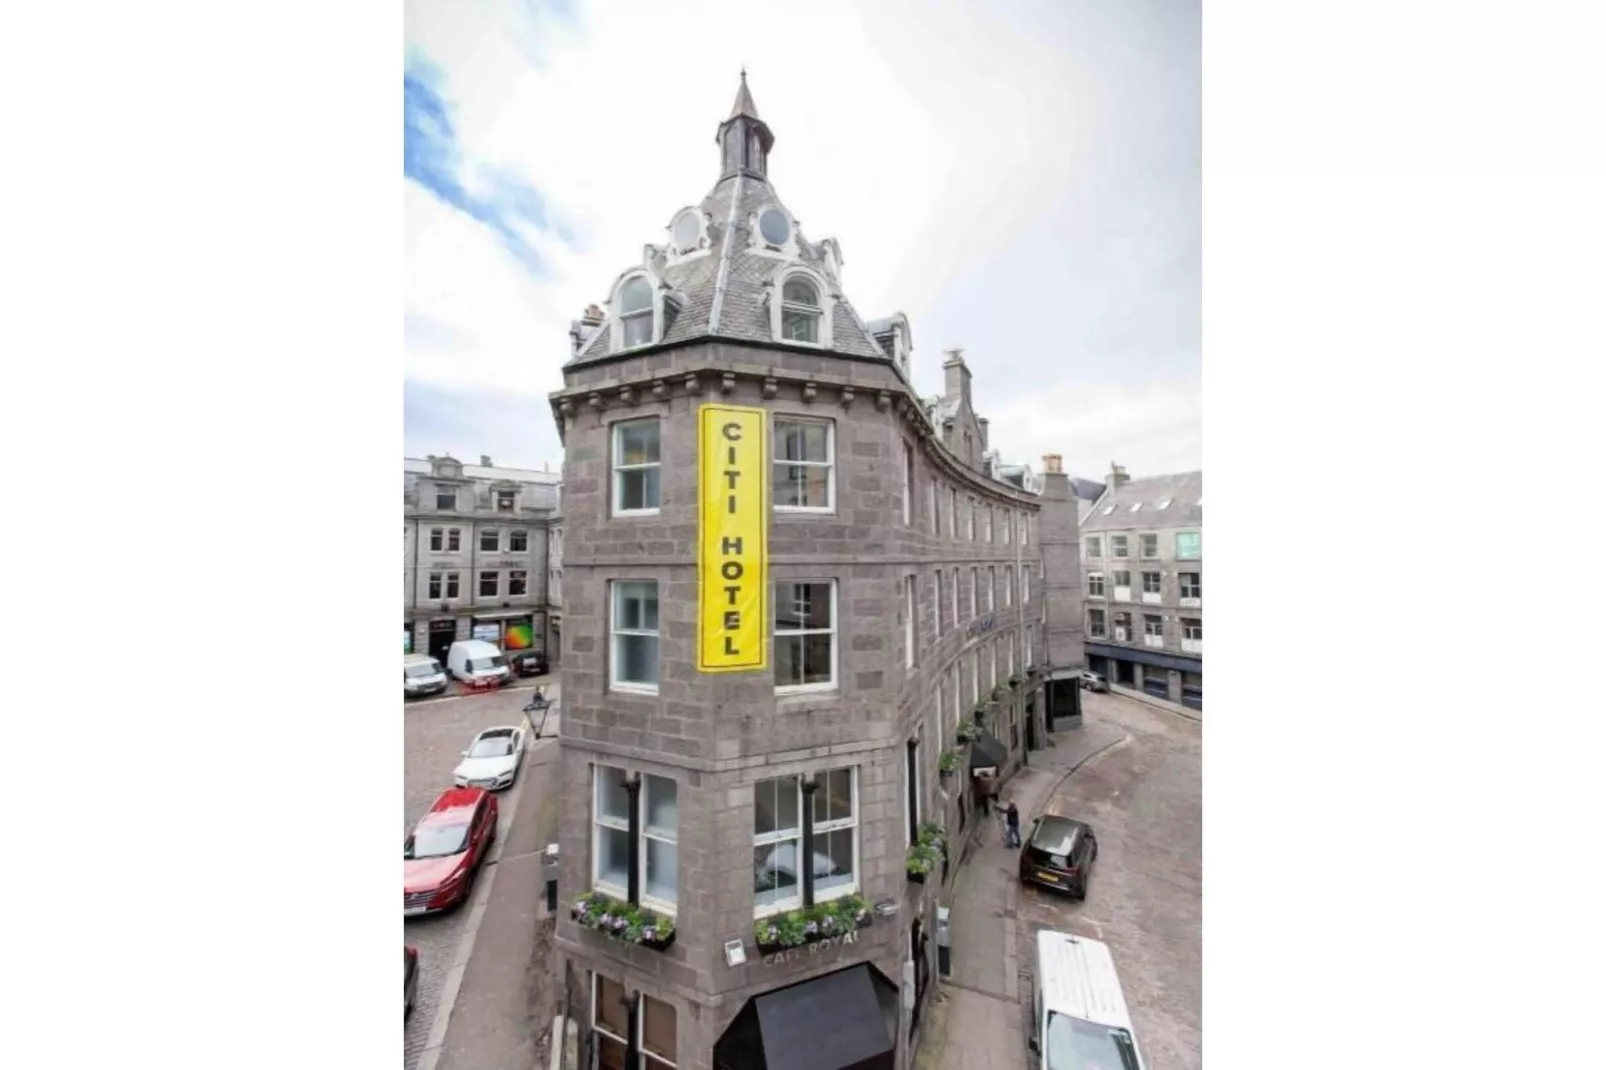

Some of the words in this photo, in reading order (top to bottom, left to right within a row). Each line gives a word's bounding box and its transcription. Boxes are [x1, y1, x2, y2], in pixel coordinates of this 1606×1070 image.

[722, 422, 742, 514] CITI
[721, 537, 744, 655] HOTEL
[809, 931, 859, 954] ROYAL
